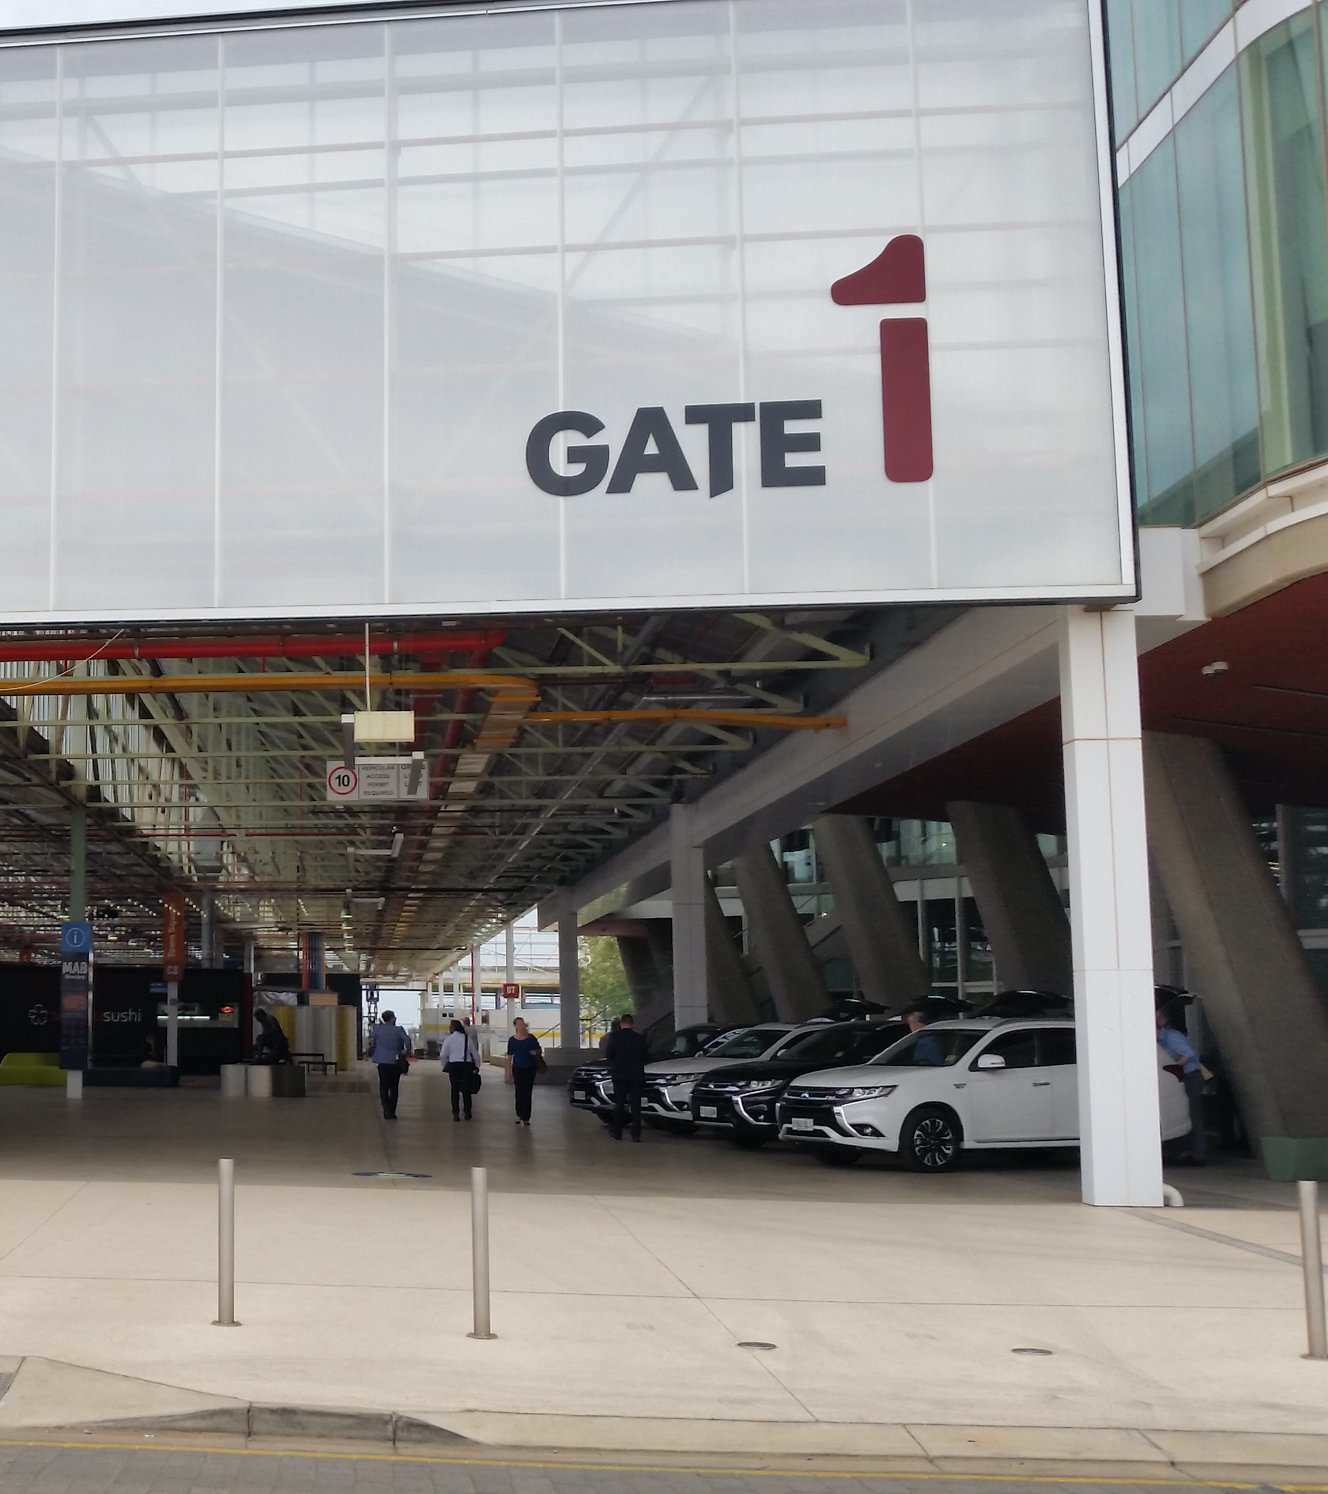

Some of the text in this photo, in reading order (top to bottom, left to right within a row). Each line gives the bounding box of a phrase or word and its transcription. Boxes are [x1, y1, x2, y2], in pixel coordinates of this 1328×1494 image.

[525, 233, 934, 498] GATE 1
[335, 774, 351, 787] 10
[62, 961, 88, 974] MAB
[103, 1008, 142, 1022] sushi
